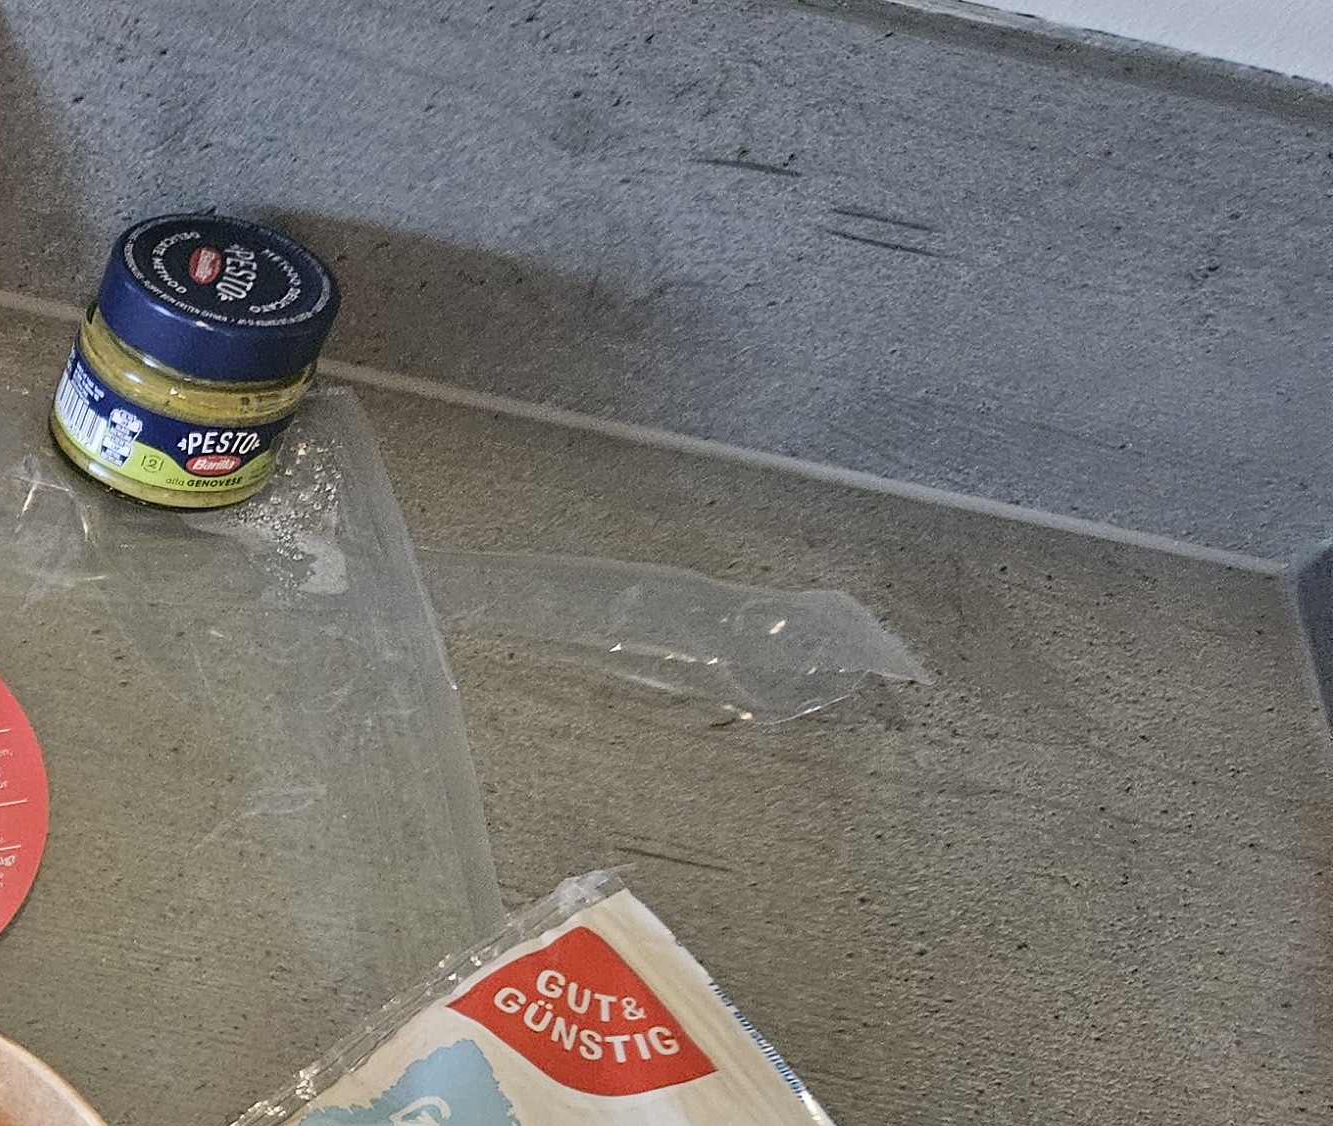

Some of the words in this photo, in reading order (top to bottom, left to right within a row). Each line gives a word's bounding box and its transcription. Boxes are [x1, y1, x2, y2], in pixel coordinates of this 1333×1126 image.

[216, 246, 258, 300] PESTO
[188, 431, 258, 455] PESTO
[186, 476, 244, 488] GENOVESE
[536, 968, 647, 1022] GUT&
[493, 986, 681, 1063] GÜNSTIG
